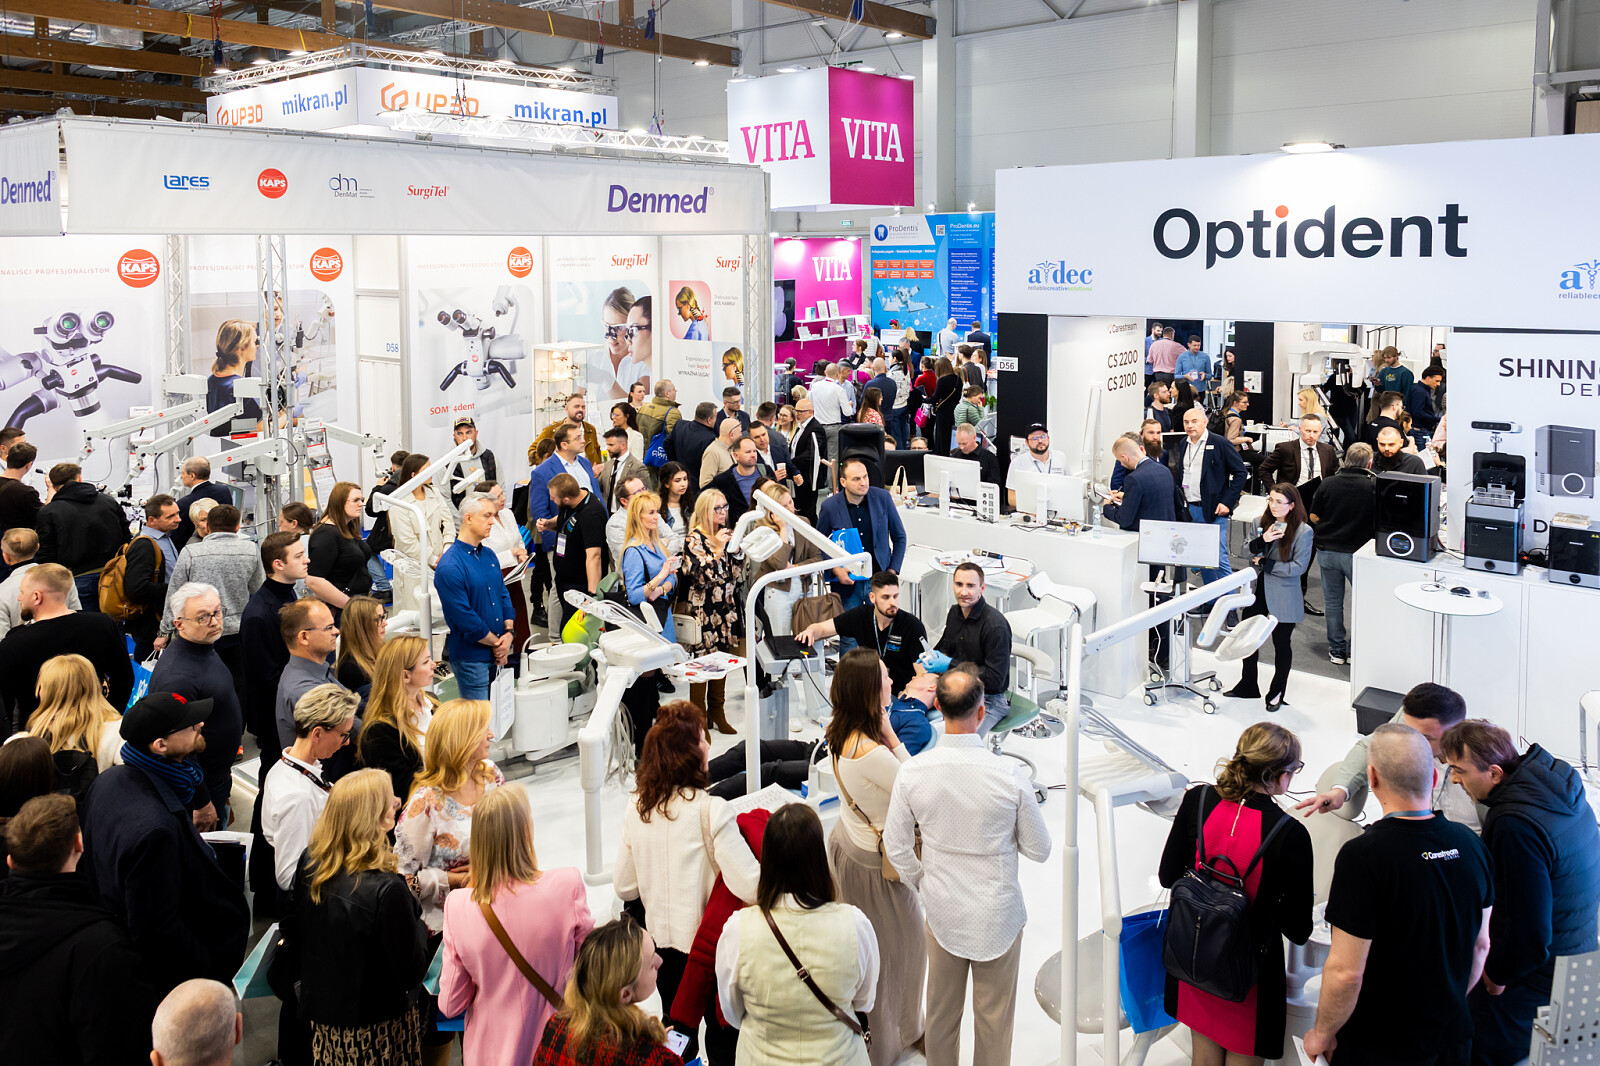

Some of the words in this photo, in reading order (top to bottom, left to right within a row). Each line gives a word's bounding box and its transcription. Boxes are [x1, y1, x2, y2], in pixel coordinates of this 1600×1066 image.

[282, 85, 347, 115] mikran.pl
[231, 104, 263, 126] UP3D
[514, 101, 607, 127] mikran.pl
[740, 119, 816, 163] VITA
[840, 117, 905, 163] VITA
[259, 179, 287, 188] KAPS
[334, 191, 358, 199] DenMat
[406, 184, 447, 200] SurgiTel
[607, 184, 709, 214] Denmed
[888, 224, 919, 232] ProDentis
[1152, 203, 1469, 270] Optident
[120, 262, 158, 273] KAPS
[312, 259, 341, 270] KAPS
[509, 256, 532, 266] KAPS
[610, 254, 649, 270] SurgiTel
[811, 256, 853, 282] VITA
[35, 267, 110, 276] PROFESJONALISTOM
[1112, 323, 1138, 334] Carestream
[386, 343, 400, 353] D58
[999, 361, 1015, 370] D56
[1107, 353, 1118, 369] CS
[1119, 349, 1139, 367] 2200
[1498, 357, 1600, 380] SHININ
[1107, 376, 1118, 392] CS
[1119, 371, 1137, 389] 2100
[1427, 848, 1460, 860] Carestream
